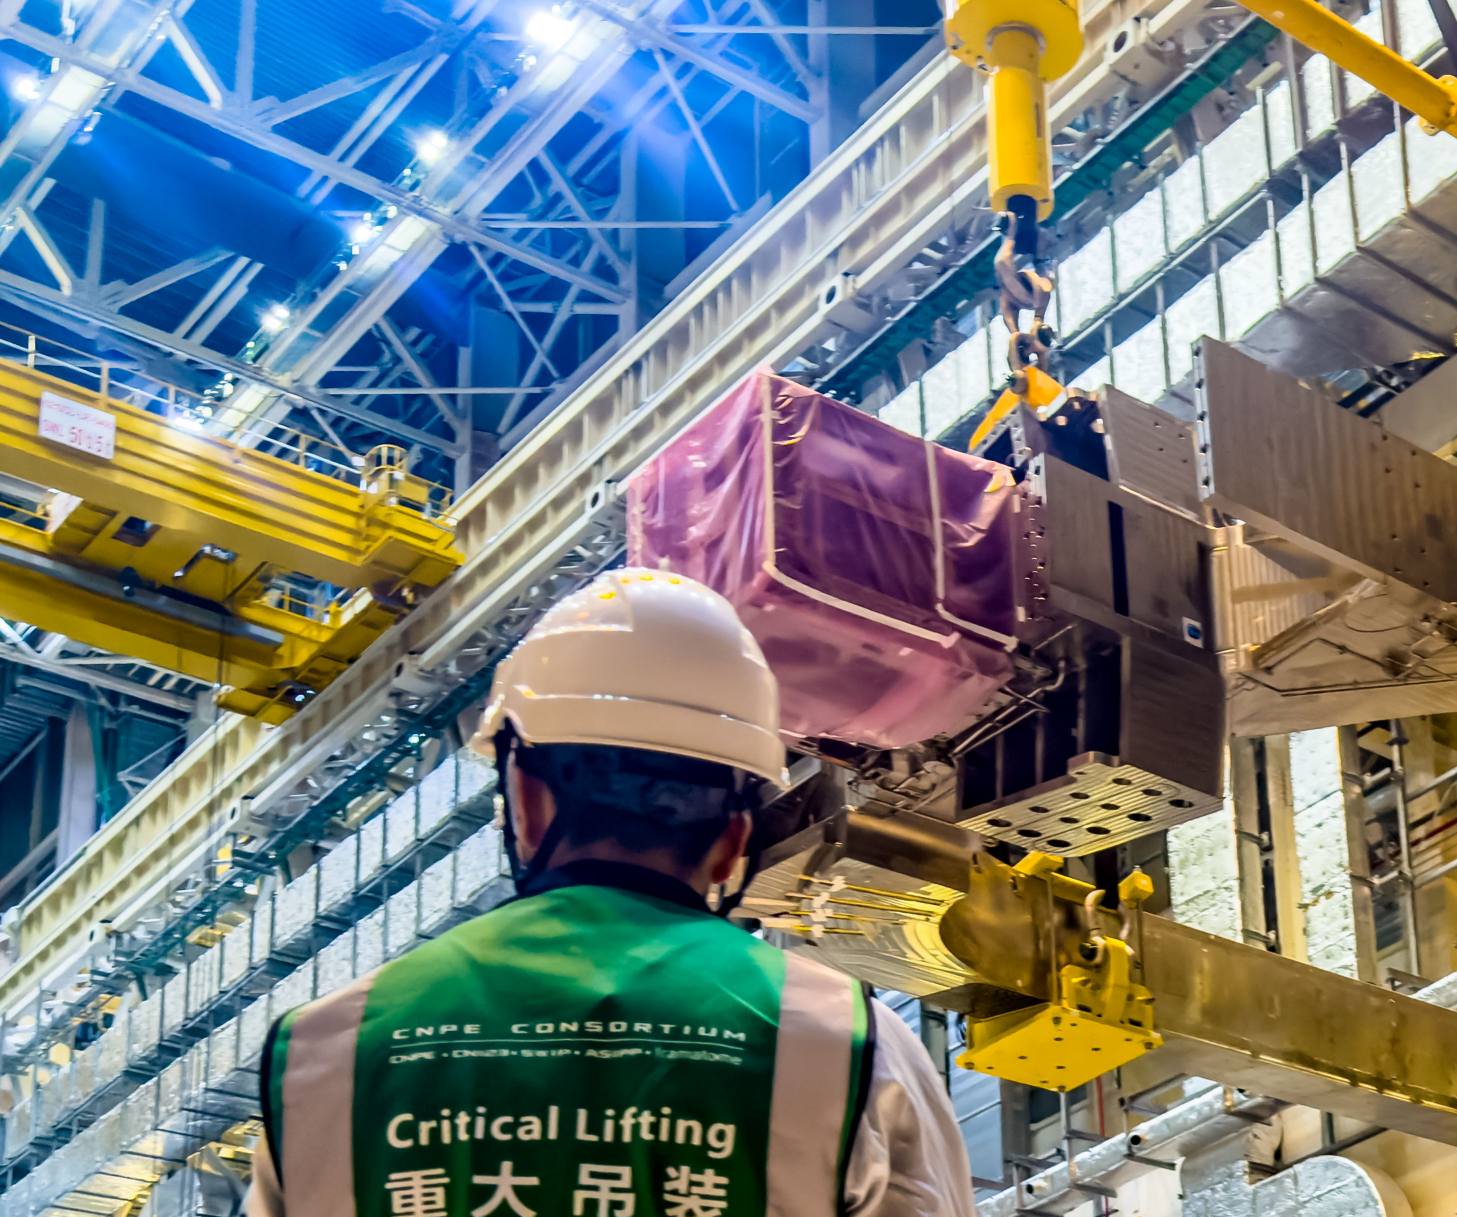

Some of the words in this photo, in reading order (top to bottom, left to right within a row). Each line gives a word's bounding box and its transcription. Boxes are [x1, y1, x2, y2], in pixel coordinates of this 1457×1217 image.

[392, 1024, 481, 1039] CNPE
[511, 1021, 746, 1041] CONSORTIUM
[387, 1105, 559, 1148] Critical
[576, 1106, 736, 1159] Lifting
